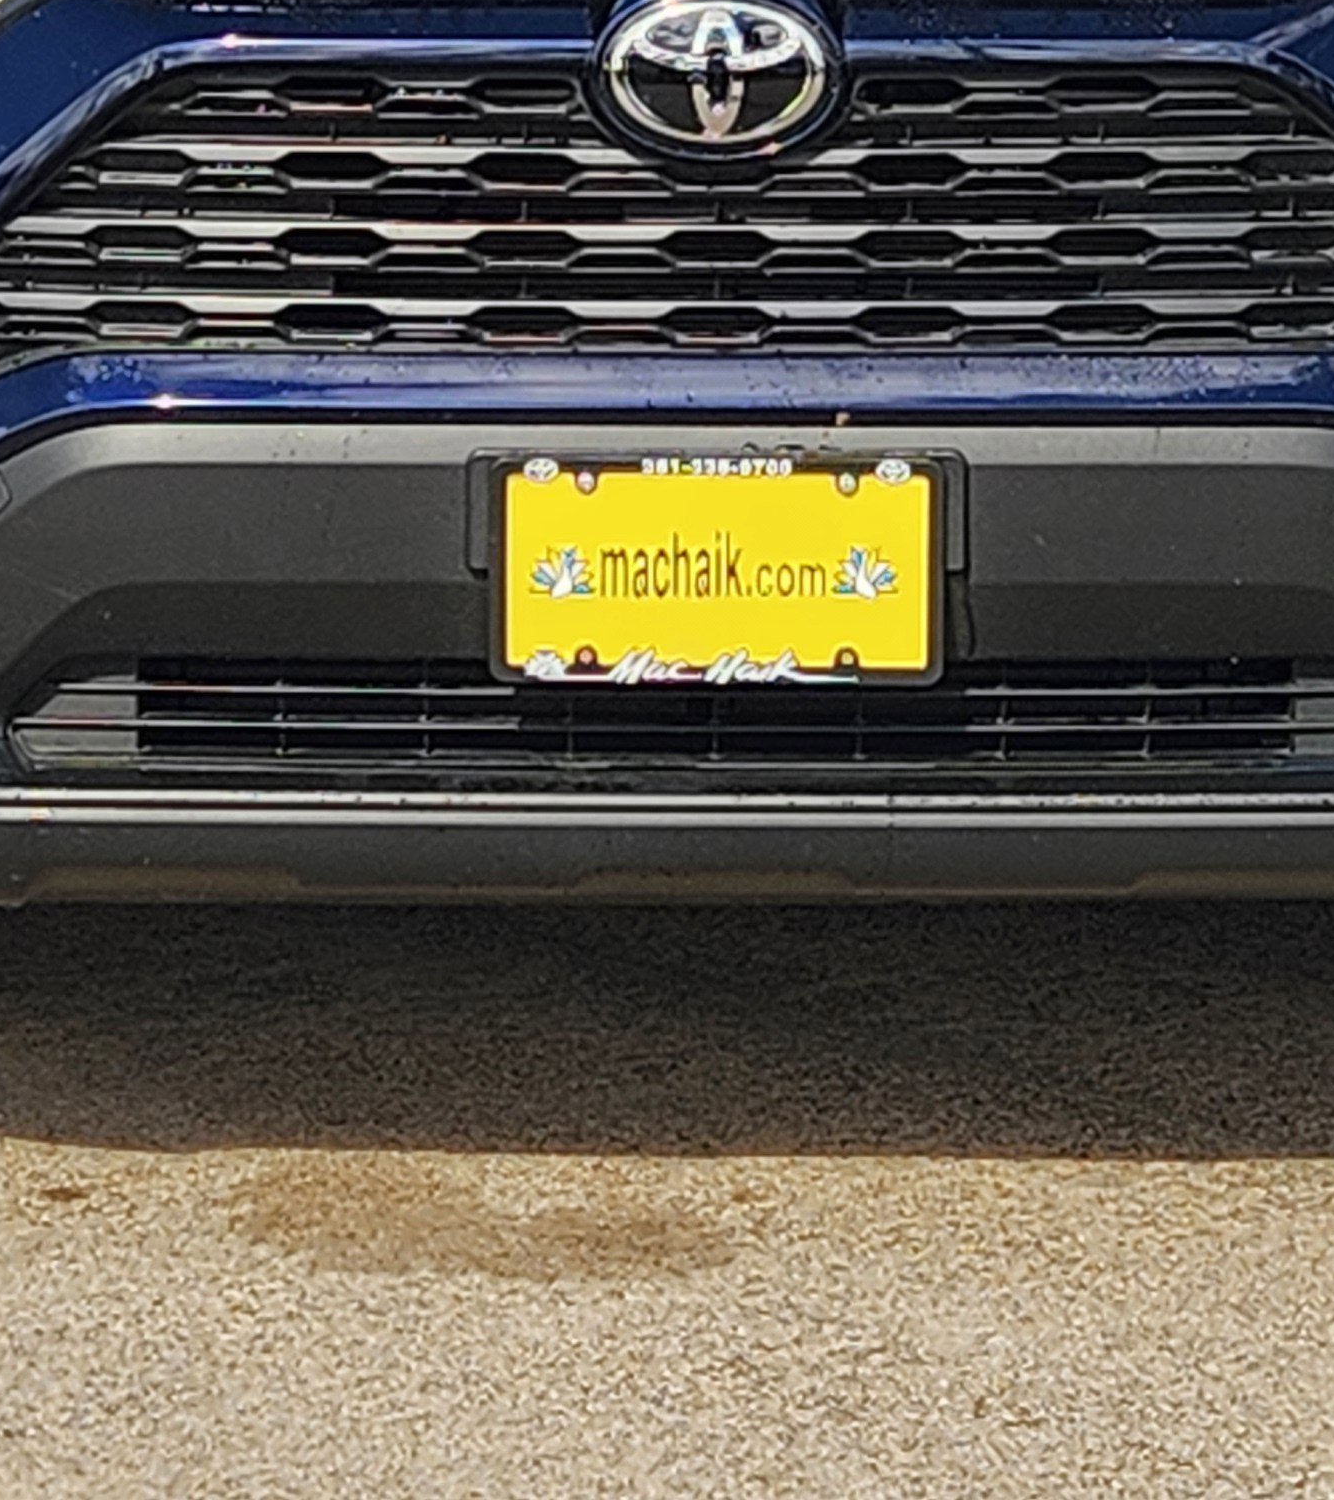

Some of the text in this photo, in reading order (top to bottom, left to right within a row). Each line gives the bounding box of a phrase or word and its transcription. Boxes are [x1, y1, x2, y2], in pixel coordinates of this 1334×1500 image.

[599, 531, 827, 598] machaik.com
[608, 645, 800, 684] Mac Haik
